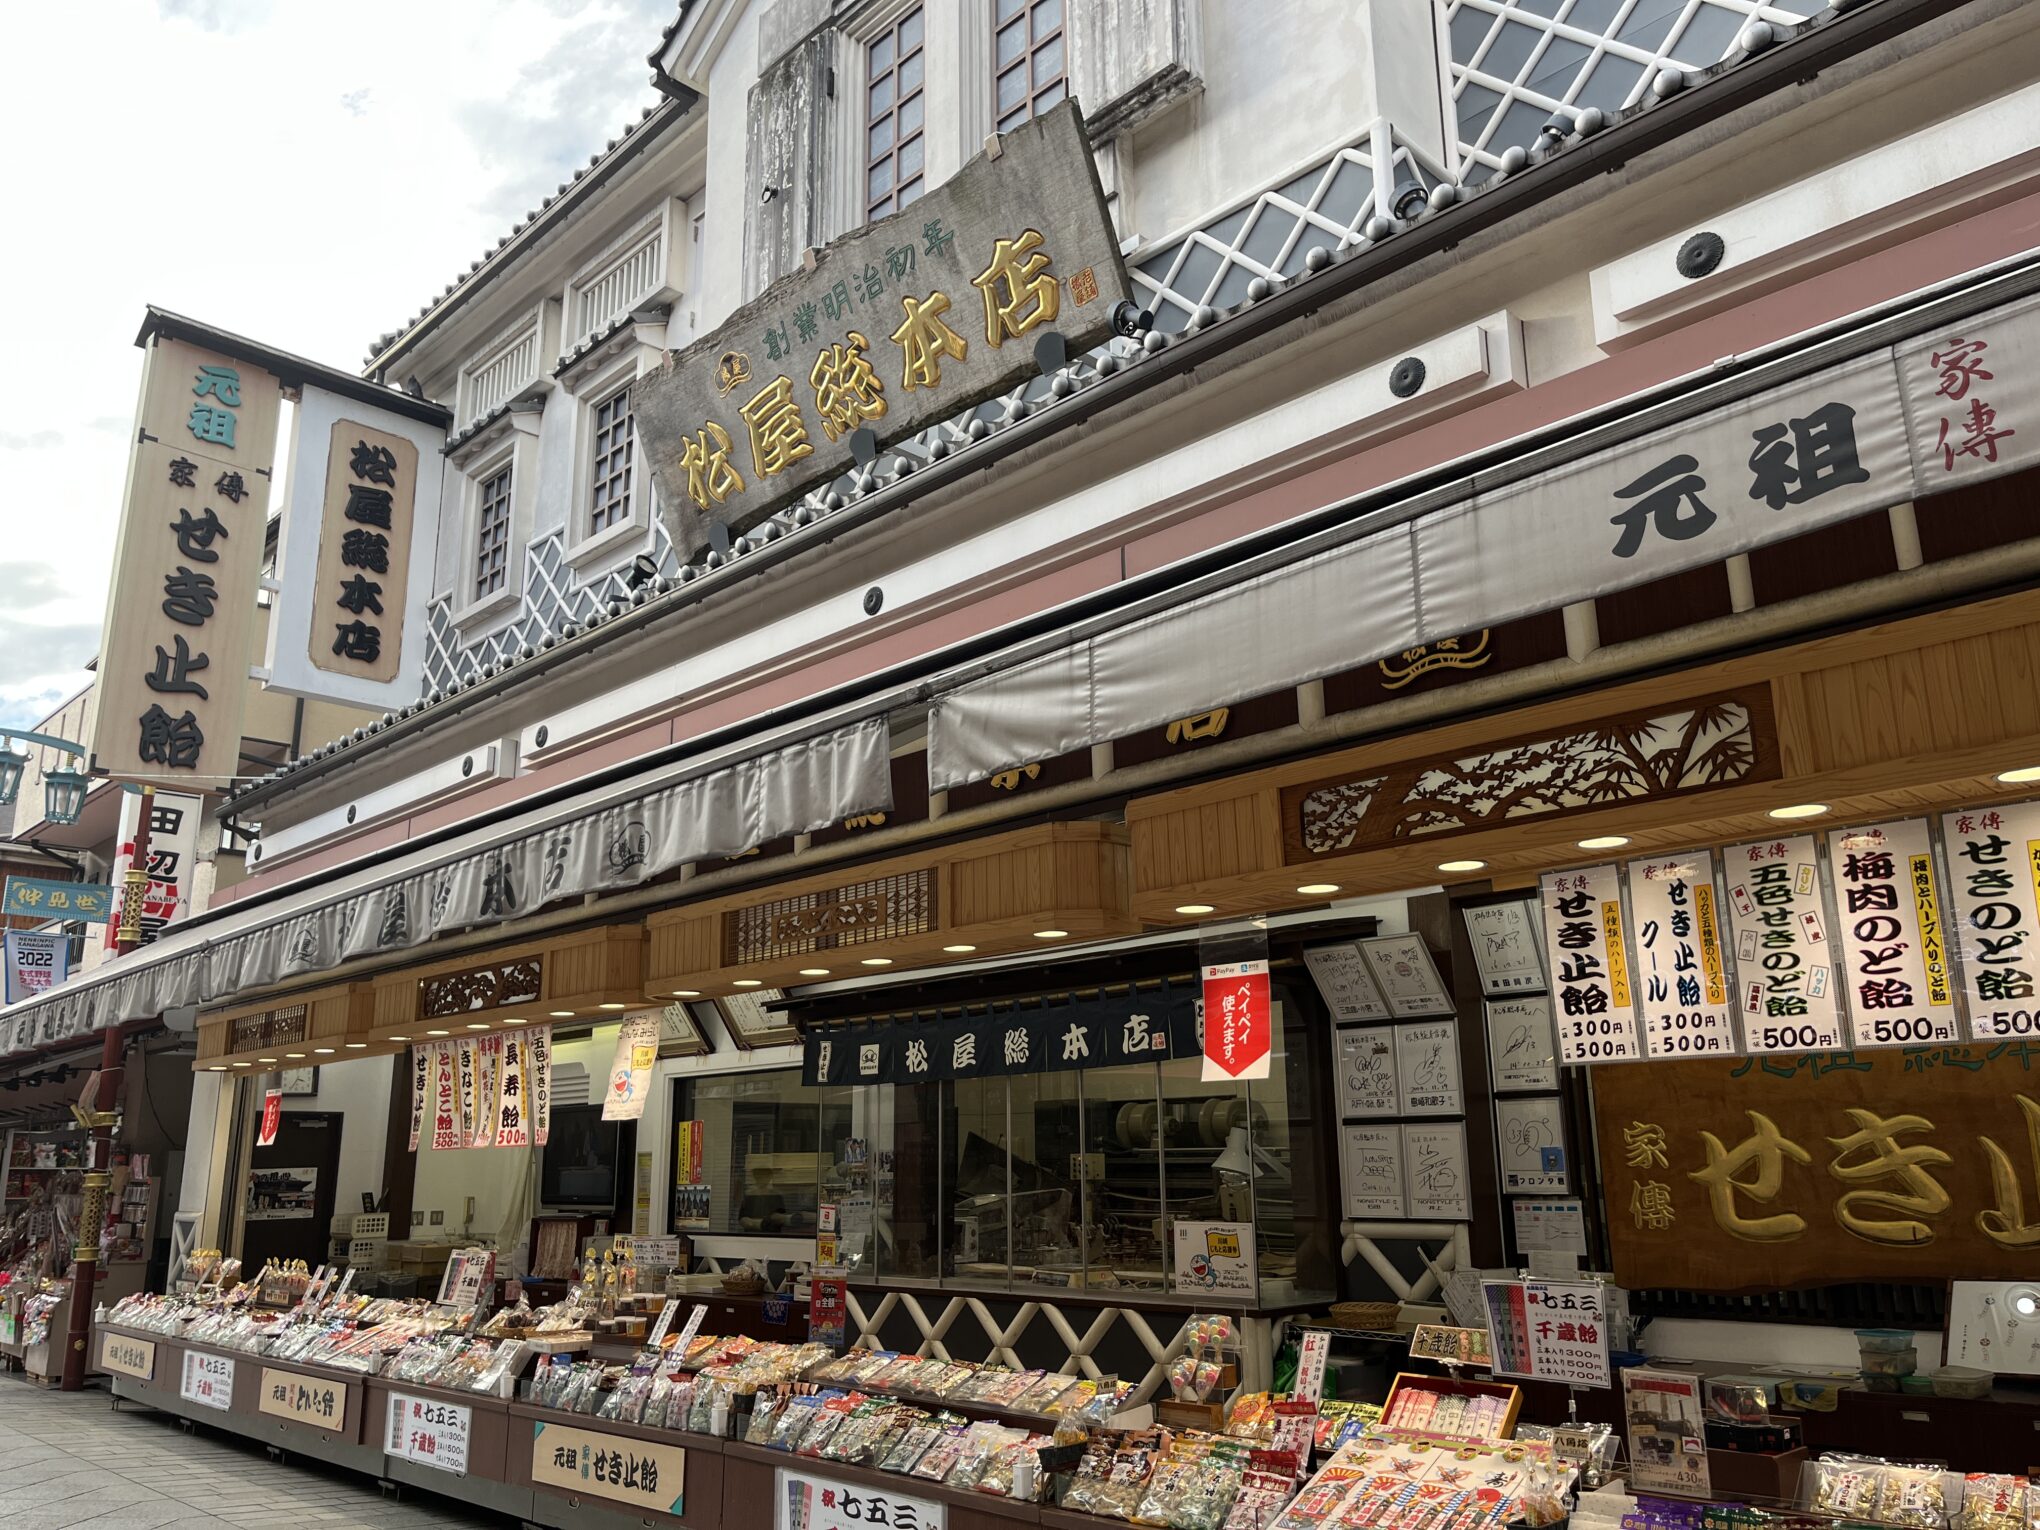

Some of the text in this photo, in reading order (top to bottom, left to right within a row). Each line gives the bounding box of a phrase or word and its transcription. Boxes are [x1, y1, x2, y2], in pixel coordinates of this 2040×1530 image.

[762, 218, 953, 361] 創業明治初年
[187, 365, 242, 449] 元祖
[1610, 402, 1870, 558] 元祖
[332, 439, 396, 663] 松屋総本店
[139, 507, 229, 769] せき止飴
[18, 887, 98, 911] 仲見世
[1958, 835, 2035, 1001] せきのど飴
[1553, 891, 1609, 1016] せき止飴
[1605, 904, 1625, 1000] 五種類のハーブ入り
[1668, 878, 1701, 1007] せき止飴
[1750, 862, 1809, 1017] 五色せきのど飴
[1843, 851, 1915, 1010] 梅肉のど飴
[1913, 859, 1947, 1002] 梅肉とハーブ入りのど飴
[17, 951, 53, 966] 2022
[1642, 920, 1667, 1002] クール
[1812, 968, 1825, 995] ハッカ
[1222, 994, 1236, 1065] 使えます。
[1237, 982, 1251, 1044] ペイペイ
[1573, 1019, 1623, 1036] 300円
[1661, 1012, 1716, 1031] 300円
[1764, 1025, 1832, 1048] 500円
[1874, 1017, 1948, 1043] 500円
[904, 1013, 1151, 1074] 松屋総本店
[1576, 1040, 1626, 1058] 500円
[1663, 1034, 1719, 1053] 500円
[413, 1054, 428, 1132] せき止飴
[436, 1052, 454, 1131] とんとこ飴
[460, 1050, 472, 1130] きなこ飴
[501, 1042, 520, 1129] 長寿飴
[534, 1037, 547, 1129] 五色せきのど飴
[435, 1139, 459, 1148] 500円
[436, 1131, 459, 1140] 300円
[498, 1129, 526, 1145] 500円
[1540, 1292, 1598, 1311] 七五三
[1417, 1331, 1457, 1355] 千歳飴
[1535, 1321, 1598, 1344] 千歳飴
[205, 1357, 227, 1375] 七五三
[272, 1385, 286, 1402] 元祖
[296, 1385, 335, 1417] とんとこ飴
[413, 1402, 458, 1428] 祝 七五三
[410, 1430, 436, 1455] 千歳飴
[1554, 1436, 1588, 1449] 八角塔
[553, 1446, 577, 1470] 元祖
[593, 1448, 658, 1493] せき止飴
[821, 1488, 918, 1530] 祝 七五三
